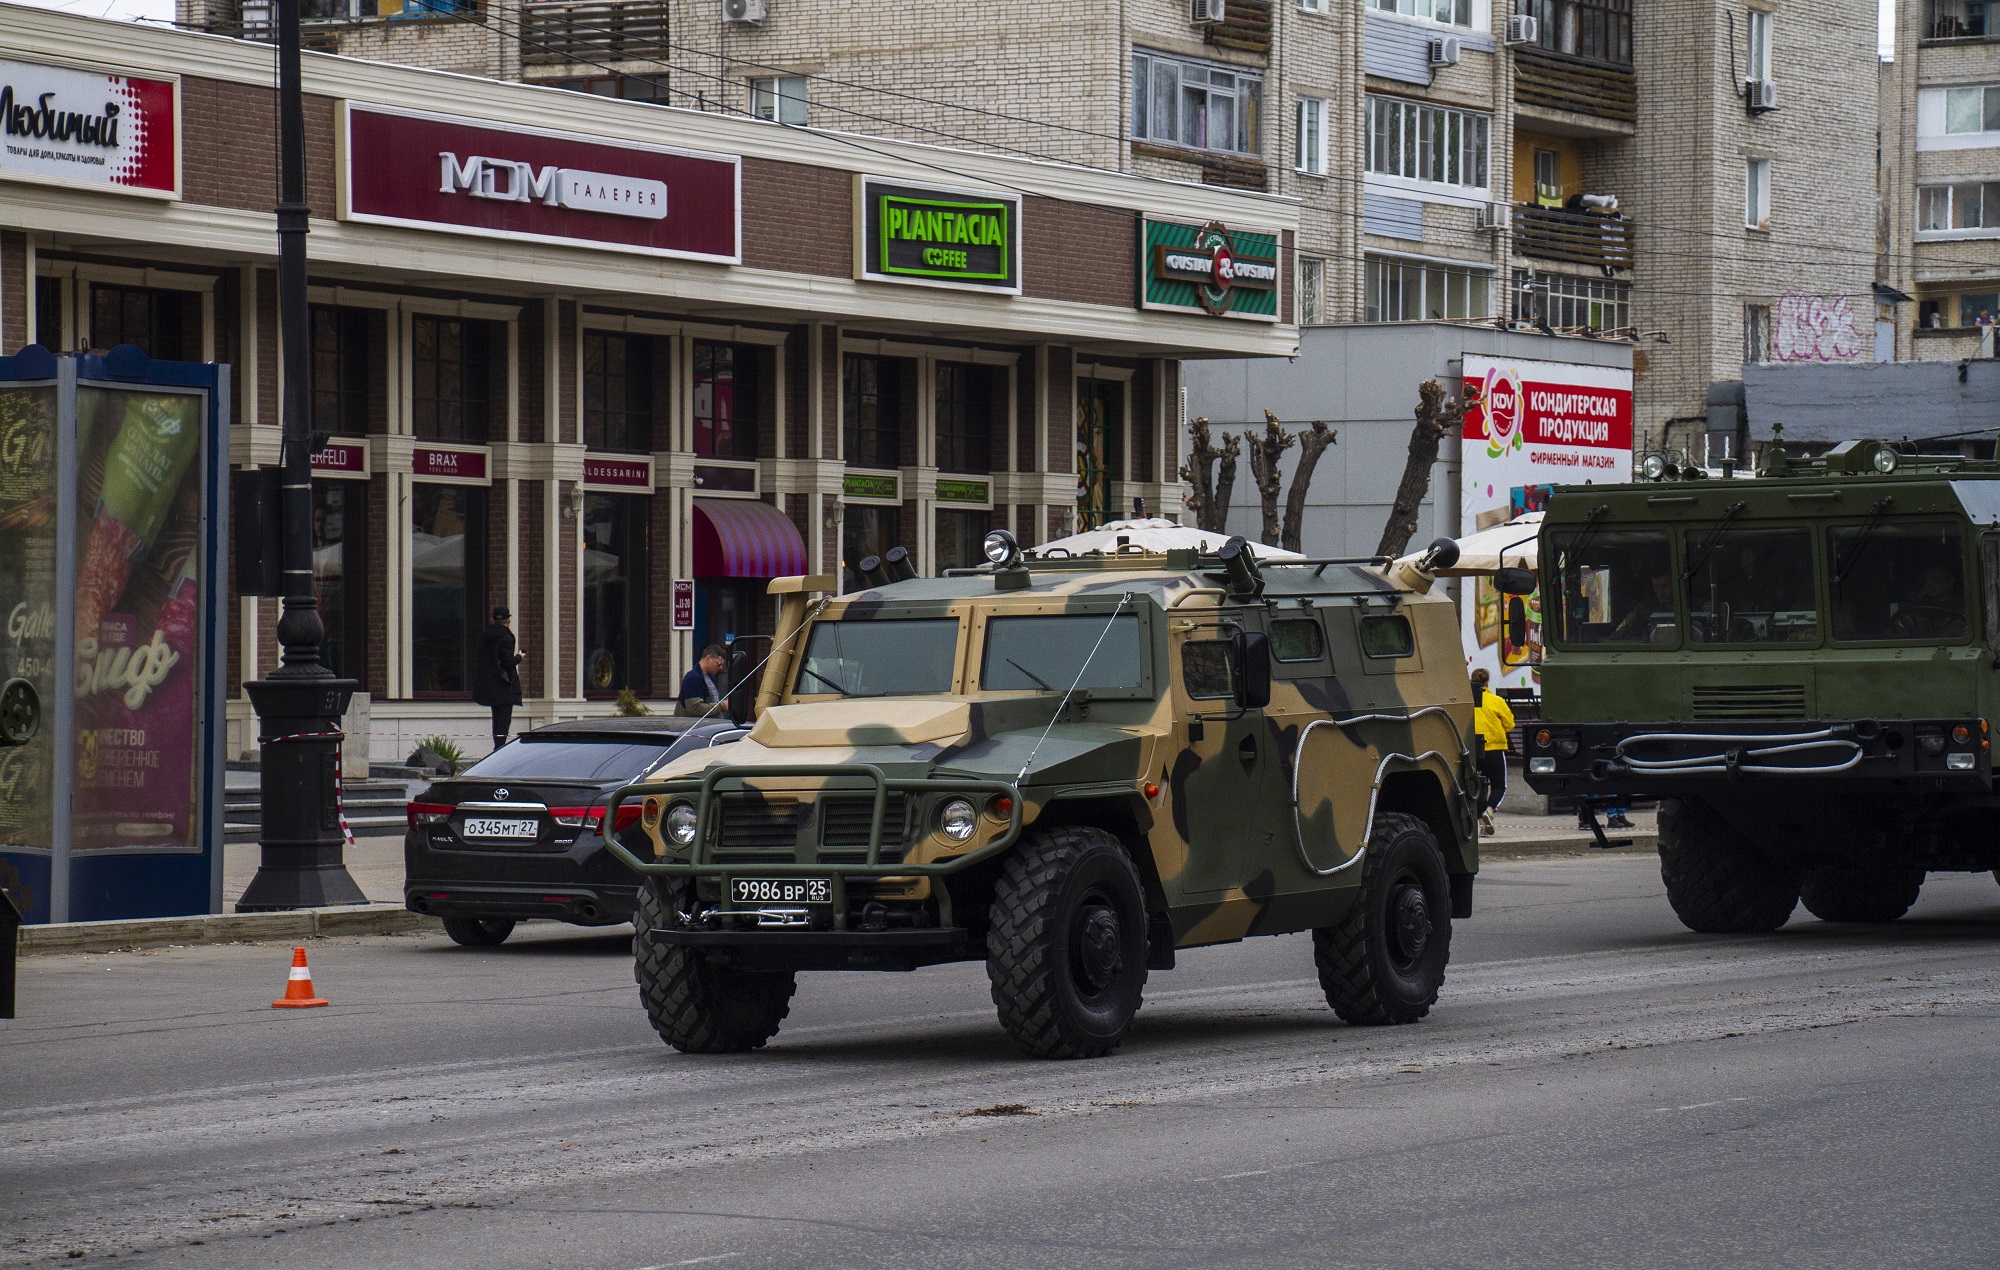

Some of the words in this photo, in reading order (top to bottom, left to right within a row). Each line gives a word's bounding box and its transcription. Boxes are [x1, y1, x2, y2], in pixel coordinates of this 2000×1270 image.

[0, 85, 120, 147] Любимый
[7, 145, 27, 156] ТОВАРЫ
[28, 148, 39, 158] ДЛЯ
[56, 152, 76, 162] КРАСОТЫ
[439, 152, 558, 206] MDM
[574, 182, 656, 205] ГАЛЕРЕЯ
[889, 207, 1002, 246] PLANTACIA
[922, 247, 967, 268] COFFEE
[1166, 255, 1213, 273] GUSTAV
[1219, 257, 1234, 279] &
[1234, 262, 1276, 280] GUSTAV
[1492, 392, 1515, 410] KDV
[1531, 391, 1617, 417] КОНДИТЕРСКАЯ
[1539, 417, 1609, 443] ПРОДУКЦИЯ
[429, 453, 457, 467] BRAX
[1530, 451, 1579, 469] ФИРМЕННЫЙ
[1582, 456, 1615, 468] МАГАЗИН
[521, 821, 534, 833] 27
[738, 881, 781, 900] 9986
[809, 881, 826, 896] 25
